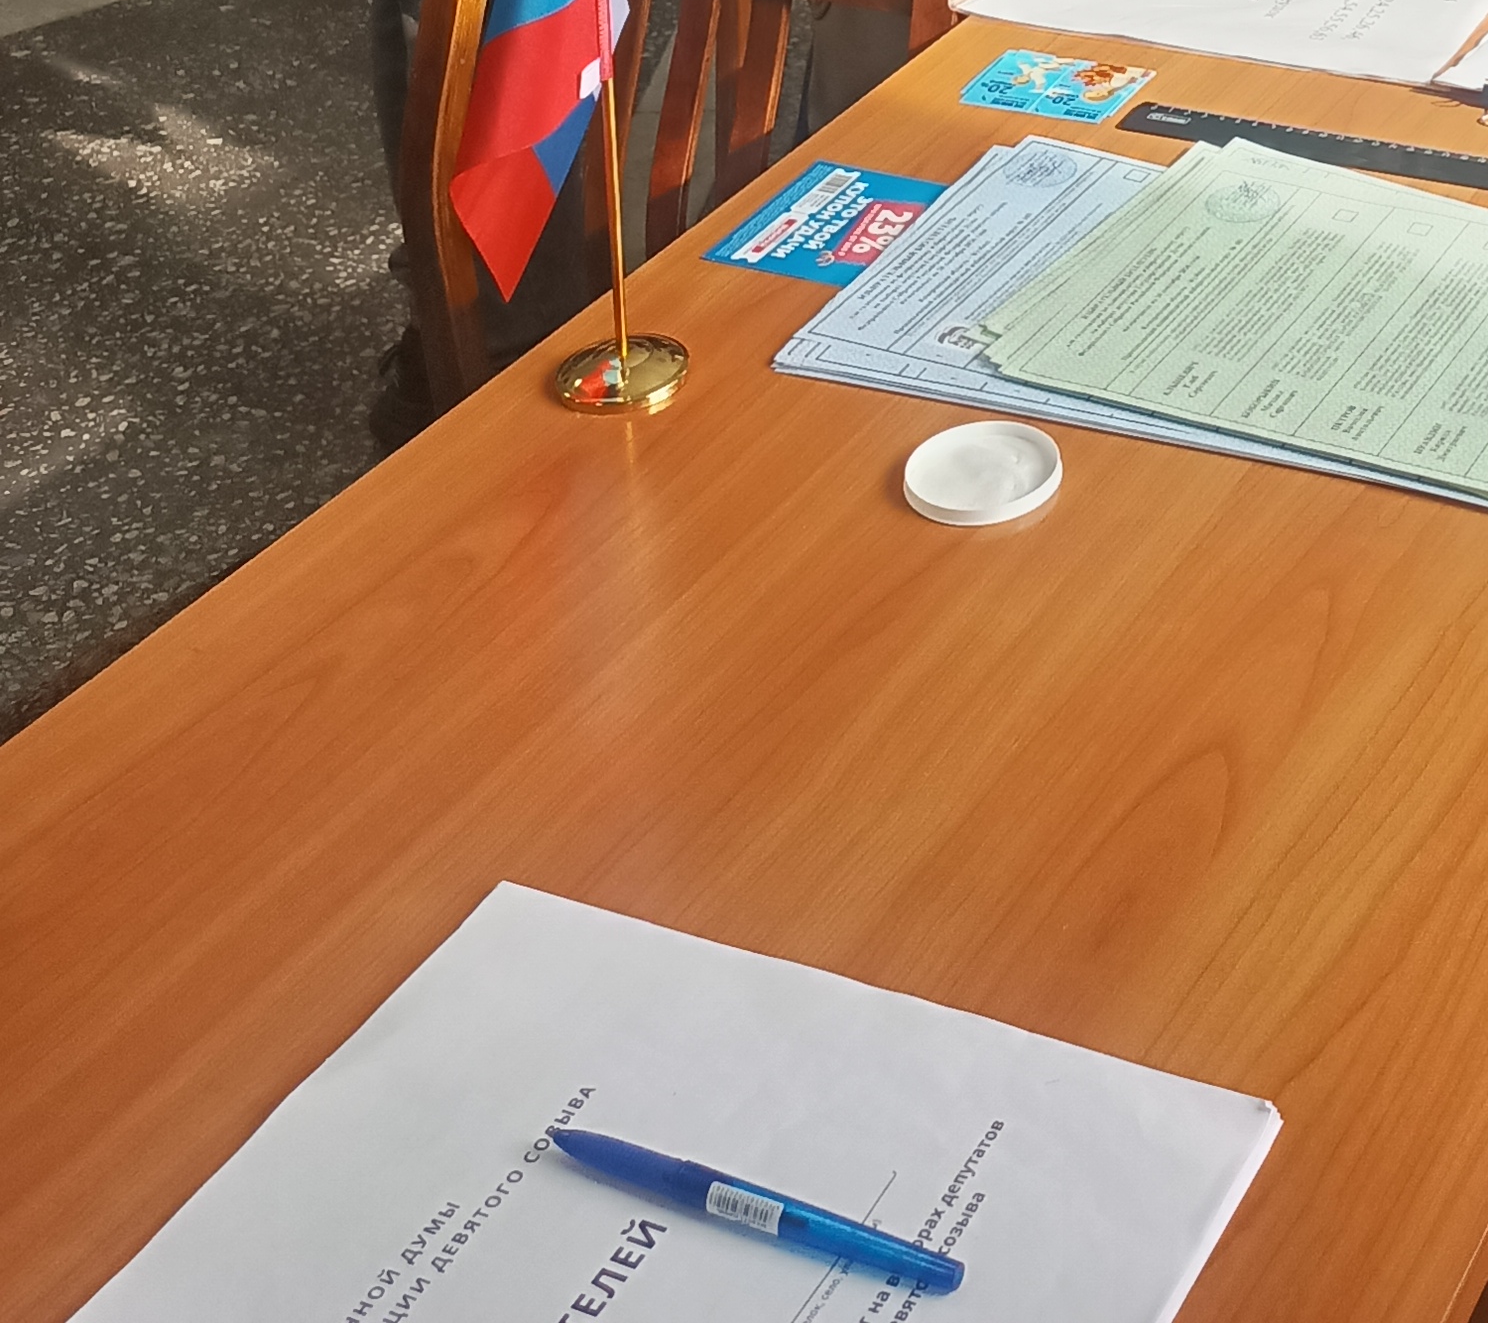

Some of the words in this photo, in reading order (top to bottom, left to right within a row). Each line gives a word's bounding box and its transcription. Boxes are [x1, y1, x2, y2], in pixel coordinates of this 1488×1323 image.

[816, 182, 869, 220] КУПОН
[841, 196, 873, 219] ЭТО
[771, 220, 825, 259] УДАЧИ
[802, 219, 850, 250] ТВОЙ
[852, 209, 913, 254] 23%
[401, 1202, 461, 1265] ДУМЫ
[431, 1169, 524, 1273] ДЕВЯТОГО
[868, 1290, 891, 1314] на
[941, 1120, 1005, 1207] депутатов
[938, 1191, 986, 1257] созыва
